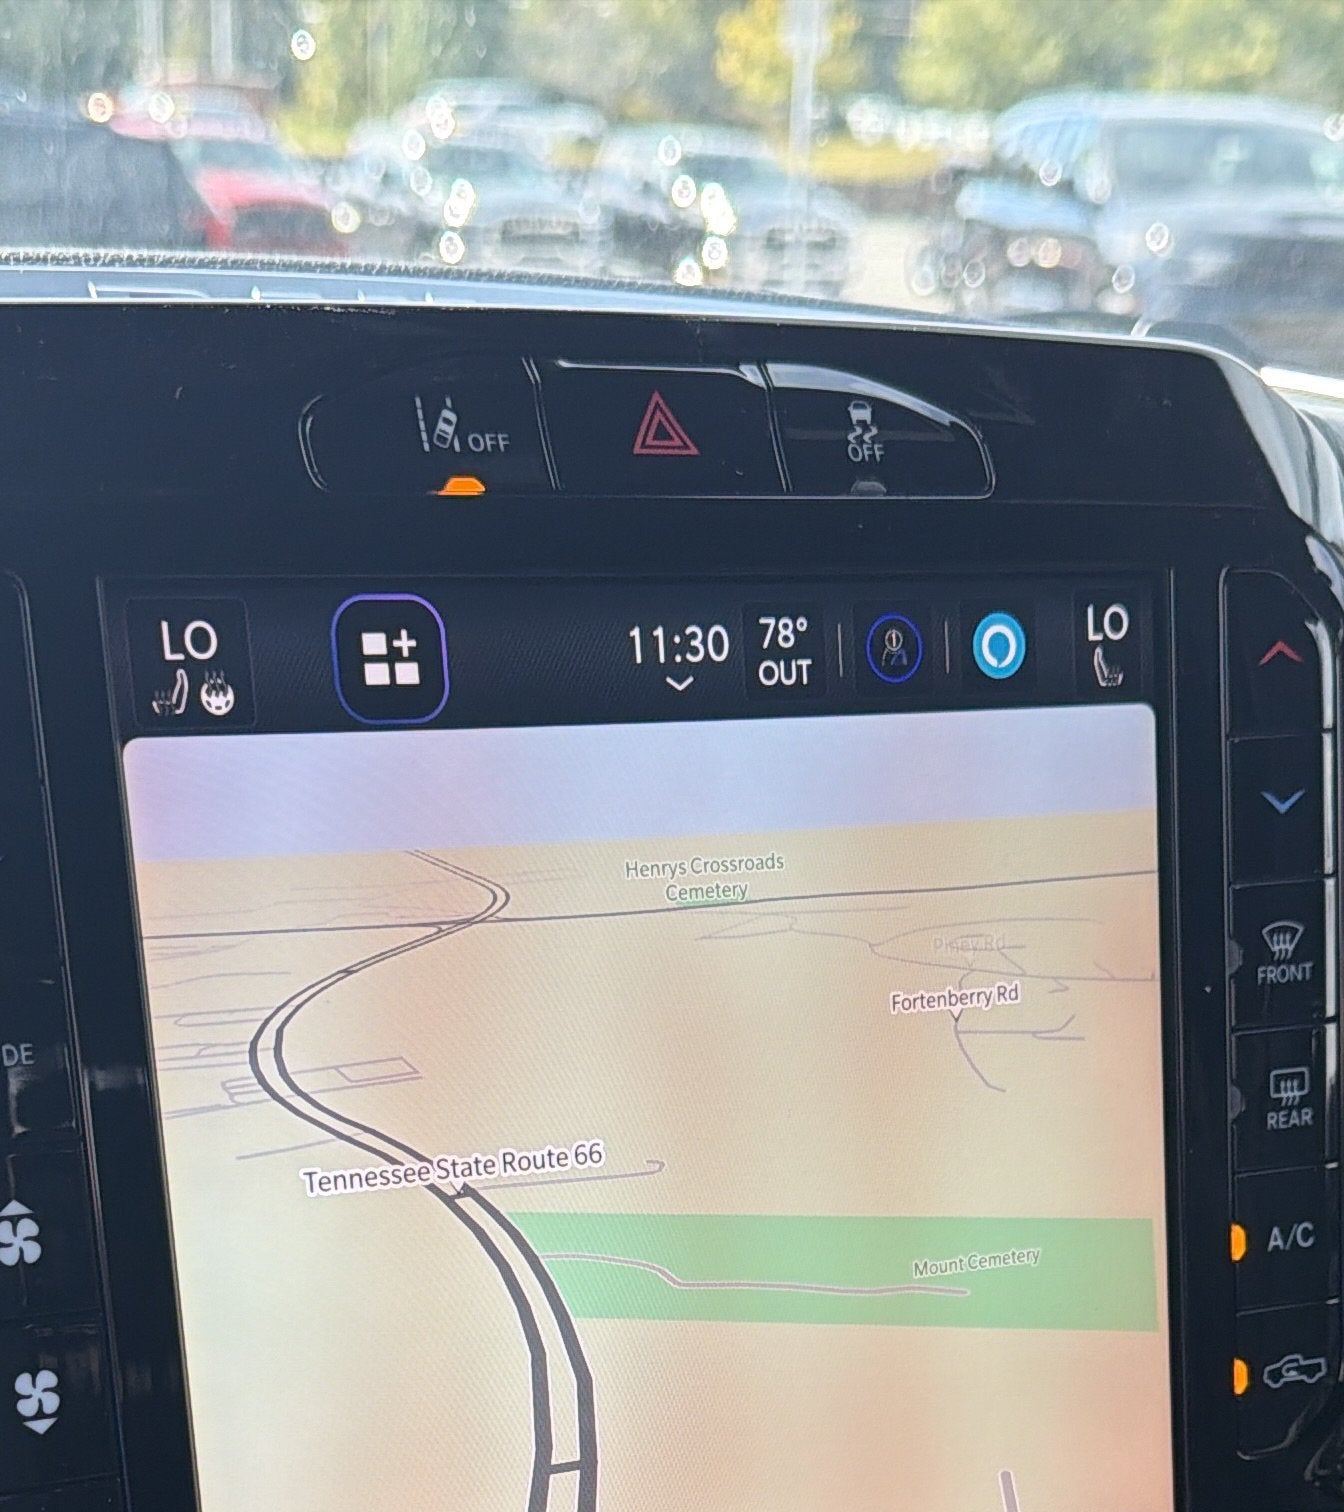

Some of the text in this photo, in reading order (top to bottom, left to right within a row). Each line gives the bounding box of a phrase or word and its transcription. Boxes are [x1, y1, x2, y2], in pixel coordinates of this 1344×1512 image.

[468, 433, 510, 453] OFF
[847, 443, 885, 463] OFF
[758, 616, 808, 649] 78°
[1087, 604, 1129, 642] LO
[161, 620, 218, 661] LO
[628, 624, 730, 664] 11:30
[758, 659, 812, 686] OUT
[625, 852, 784, 879] Henrys Crossroads
[666, 882, 748, 900] Cemetery
[1257, 961, 1314, 985] FRONT
[892, 983, 1019, 1012] Fortenberry Rd
[1266, 1108, 1314, 1131] REAR
[304, 1143, 603, 1193] Tennessee State Route 66
[1267, 1222, 1315, 1252] A/C
[914, 1249, 1040, 1277] Mount Cemetery
